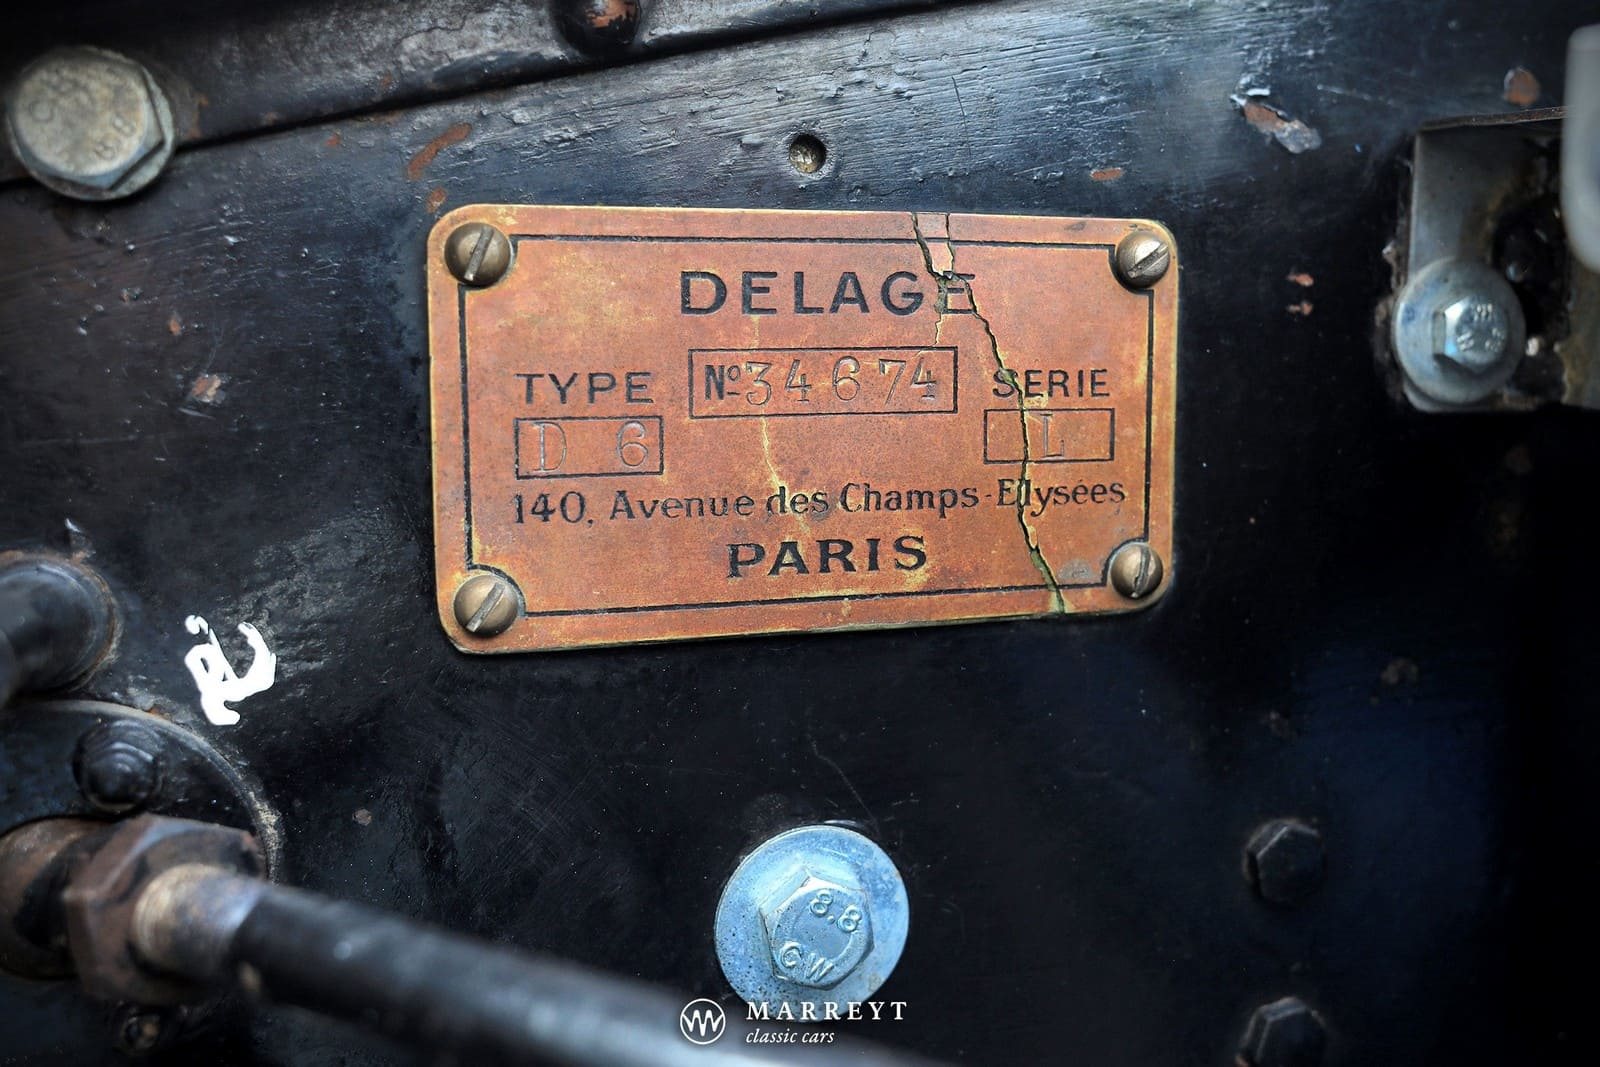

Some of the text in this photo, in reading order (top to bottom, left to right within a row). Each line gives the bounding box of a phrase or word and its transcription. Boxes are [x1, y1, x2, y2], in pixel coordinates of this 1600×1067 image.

[680, 270, 976, 316] DELAGE
[513, 371, 654, 404] TYPE
[991, 368, 1110, 398] SERIE
[531, 420, 649, 472] D 6
[1040, 413, 1065, 458] L
[610, 489, 755, 522] Avenue
[766, 485, 828, 517] des
[727, 535, 928, 580] PARIS
